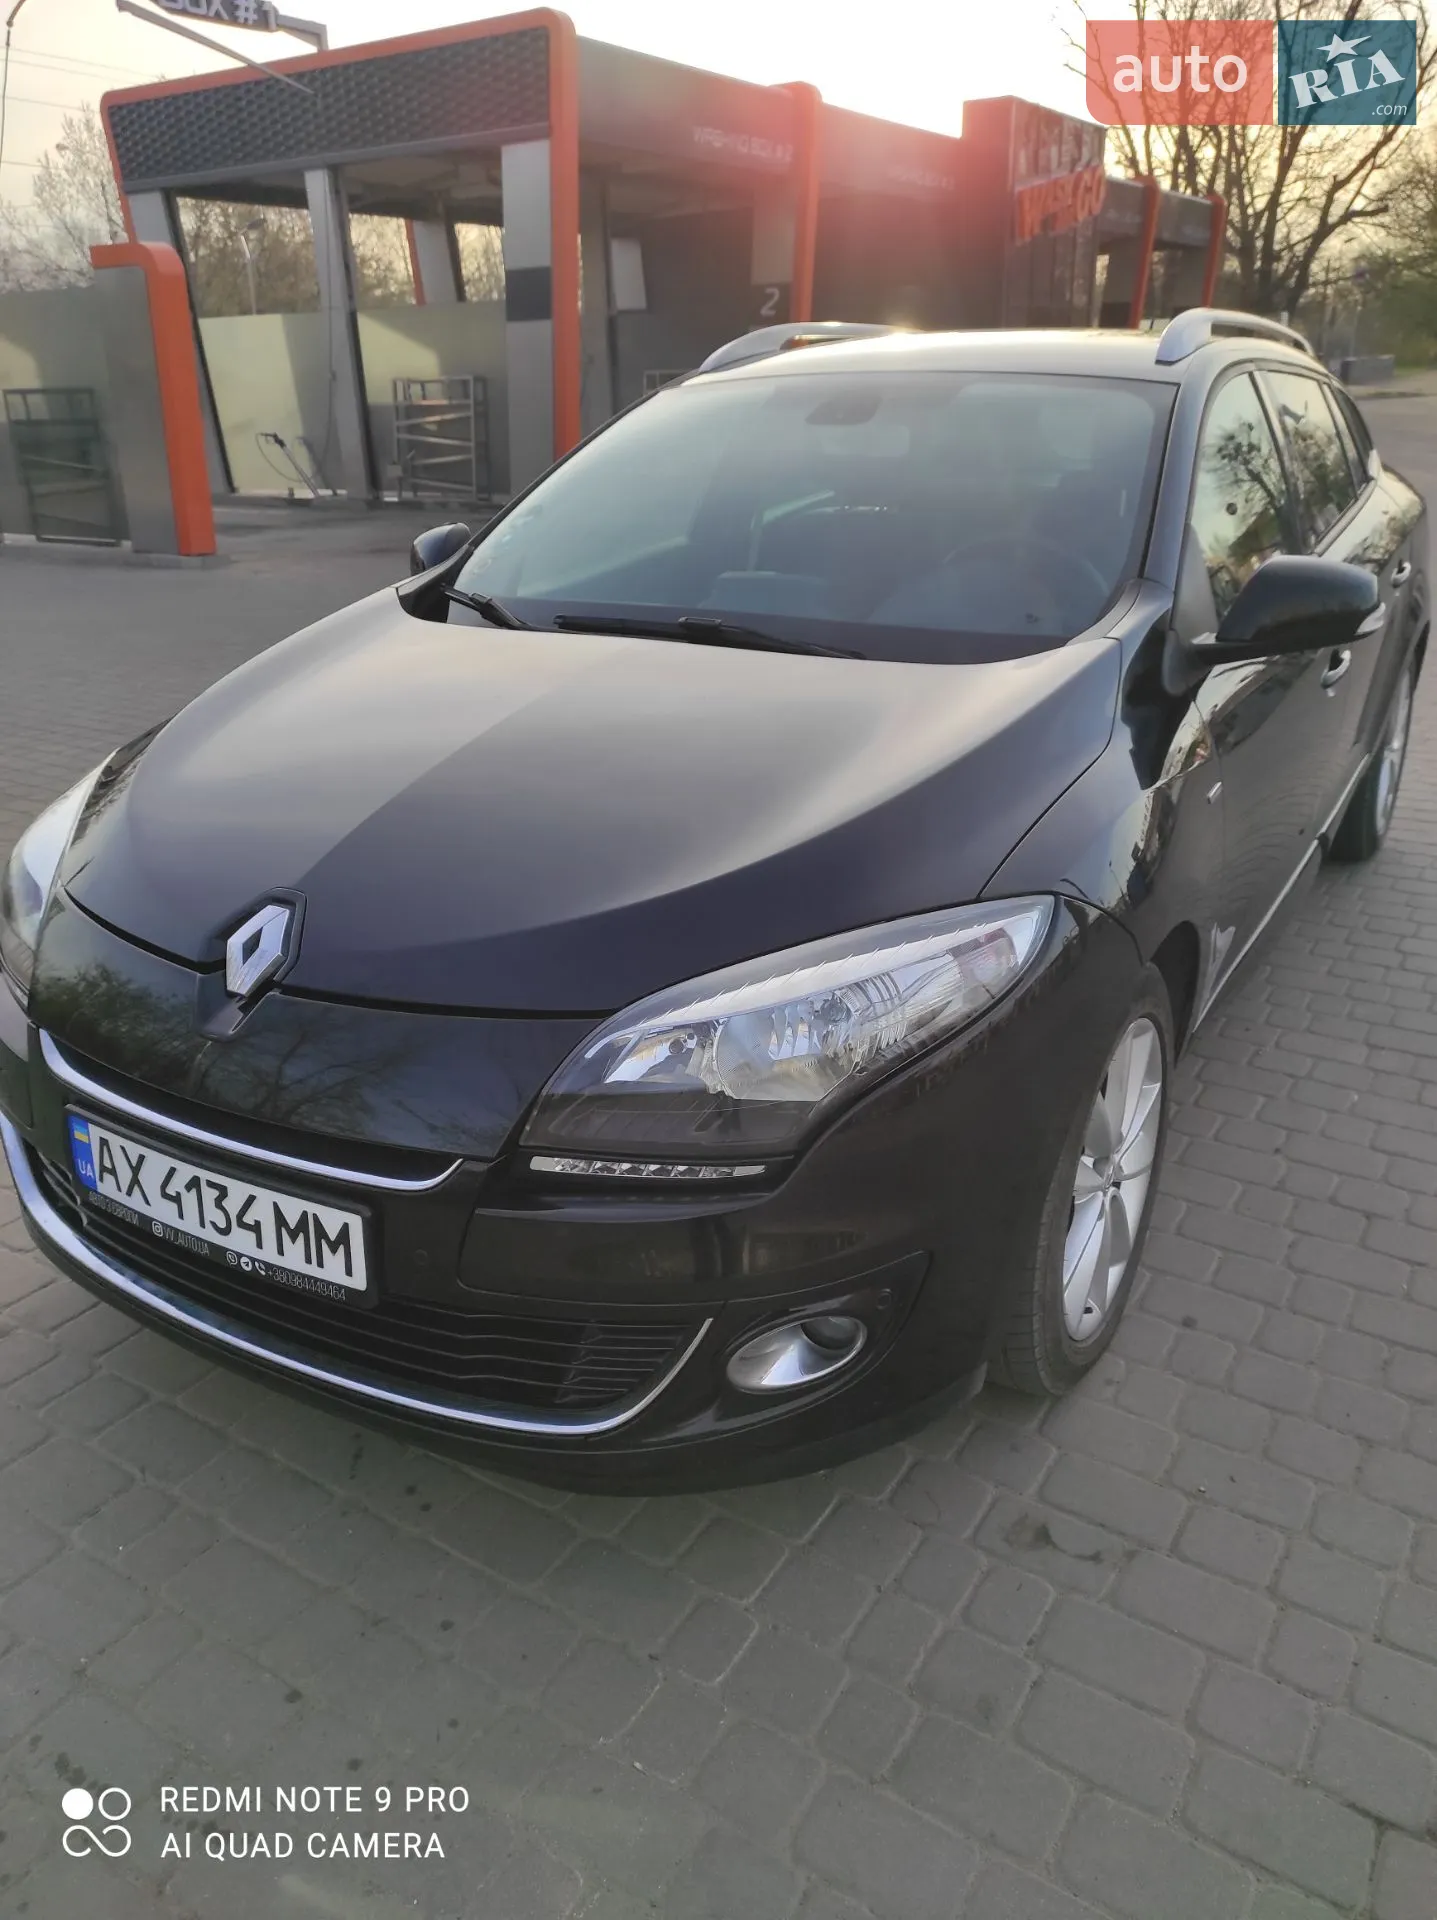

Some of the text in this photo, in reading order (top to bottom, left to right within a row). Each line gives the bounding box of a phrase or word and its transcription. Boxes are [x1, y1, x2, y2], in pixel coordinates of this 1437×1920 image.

[760, 288, 779, 317] 2
[78, 1158, 94, 1179] UA
[98, 1136, 152, 1207] AX
[160, 1166, 264, 1250] 4134
[272, 1200, 353, 1278] MM
